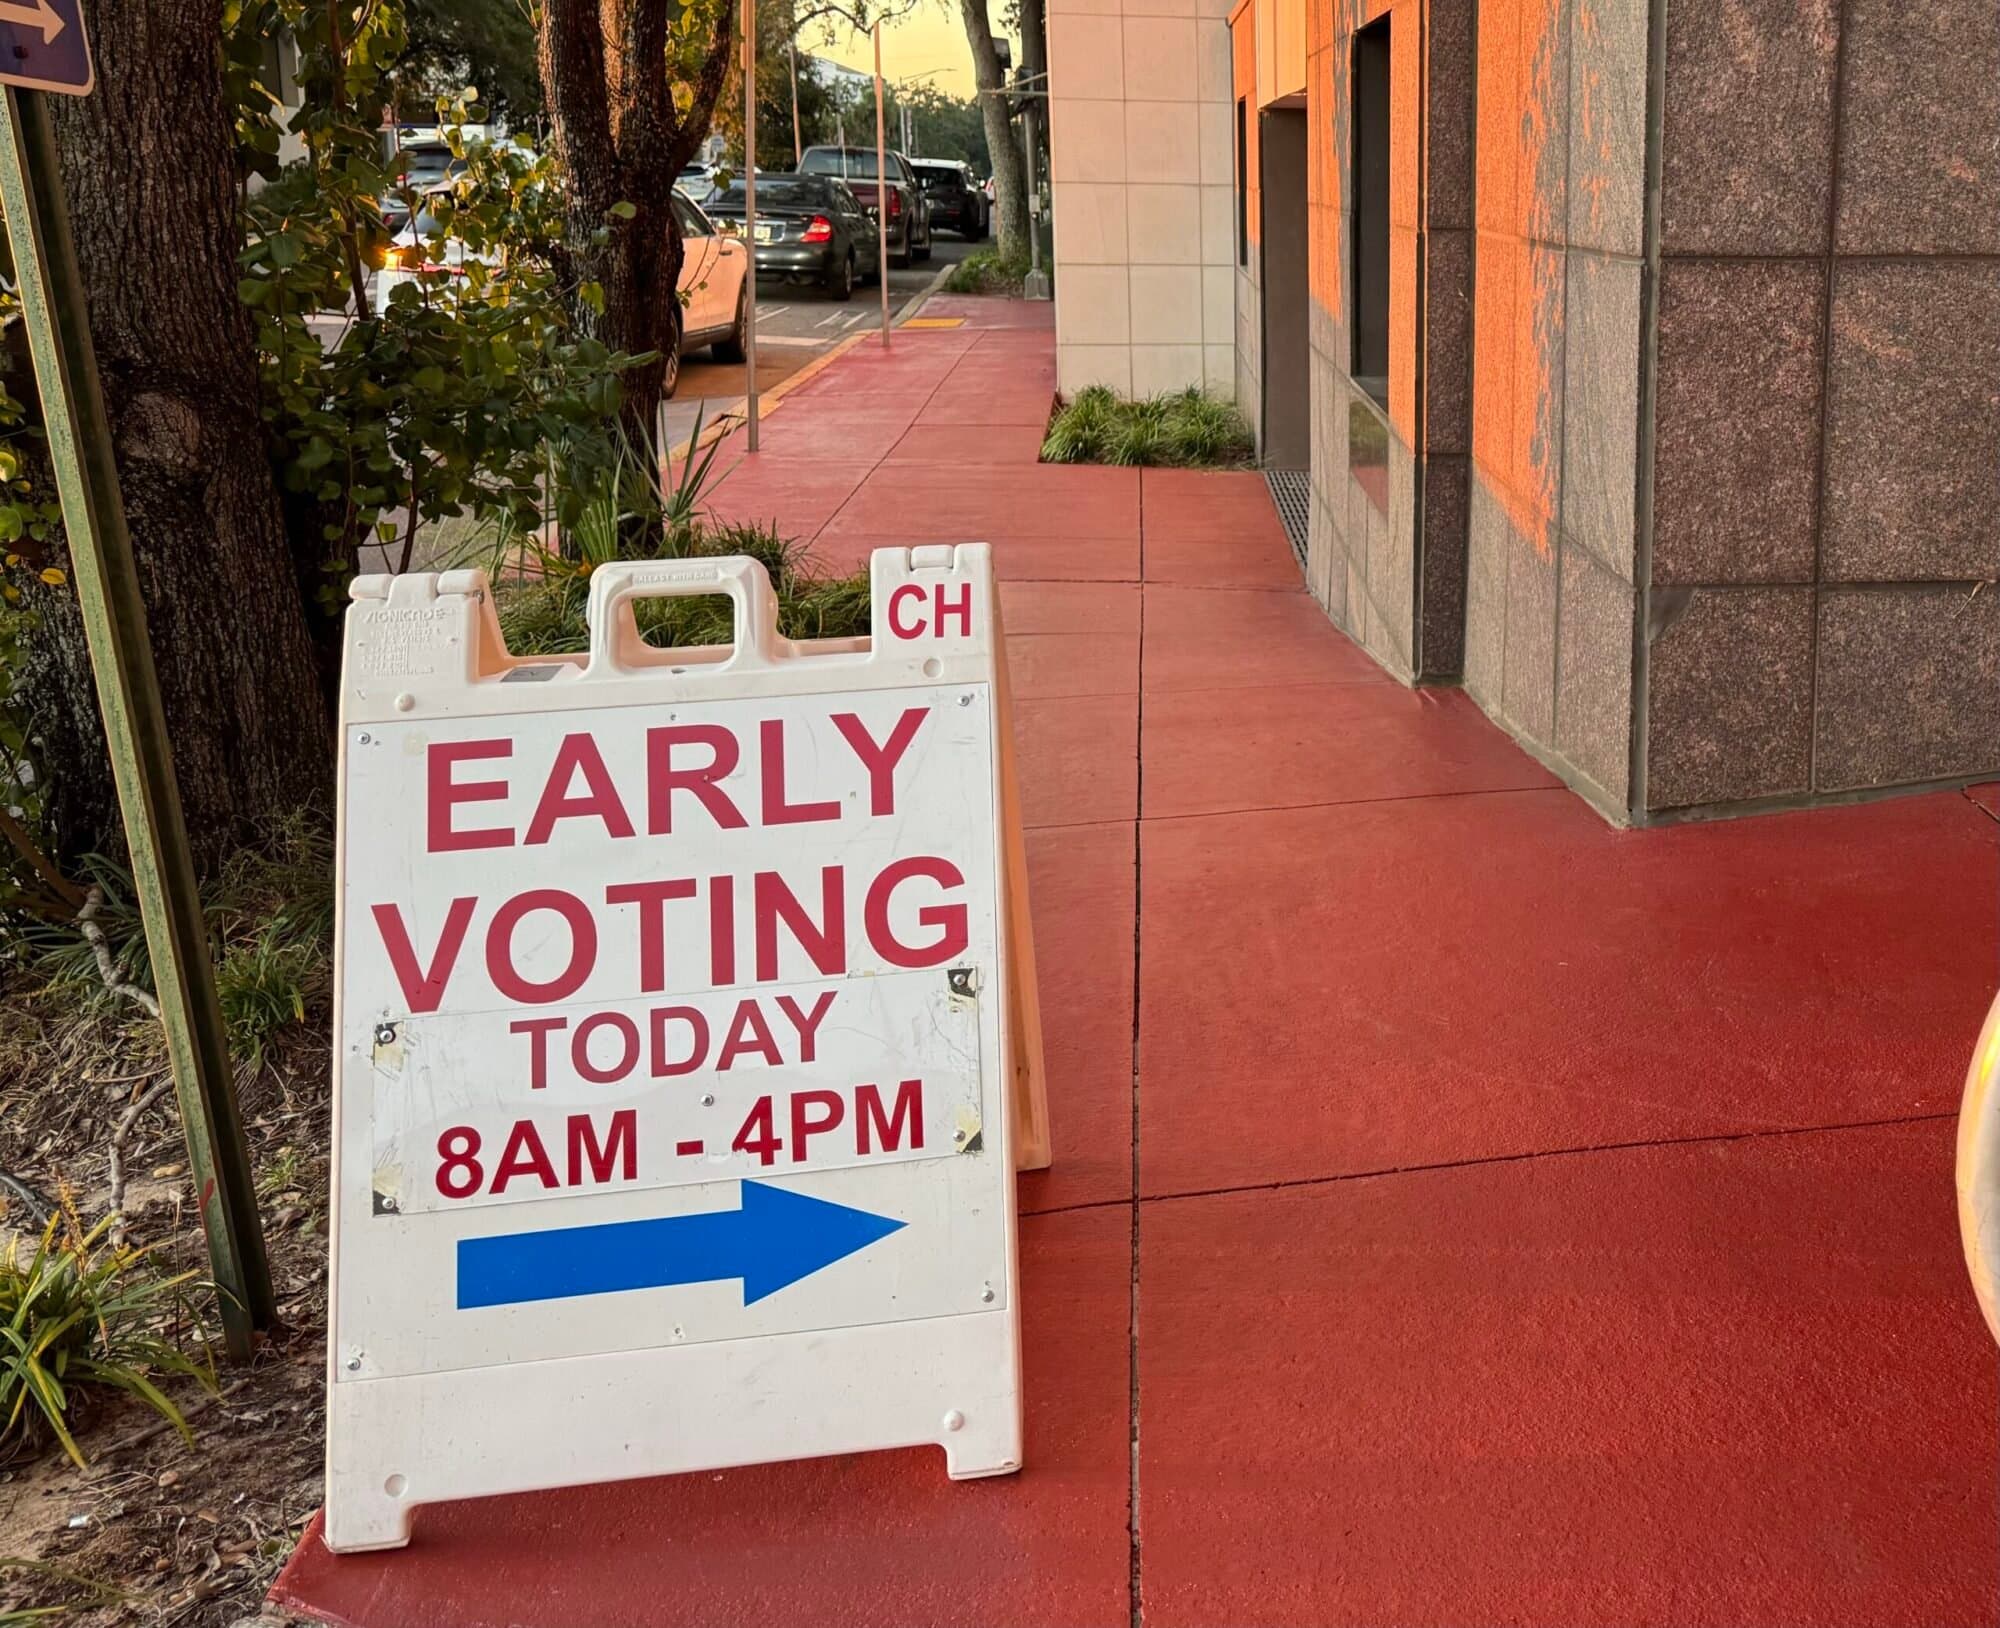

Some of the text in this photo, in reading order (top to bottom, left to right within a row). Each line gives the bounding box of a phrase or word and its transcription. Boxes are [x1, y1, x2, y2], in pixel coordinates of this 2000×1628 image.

[889, 584, 971, 640] CH
[428, 707, 929, 853] EARLY
[371, 856, 969, 1013] VOTING
[511, 991, 836, 1089] TODAY
[435, 1079, 924, 1199] 8AM - 4PM
